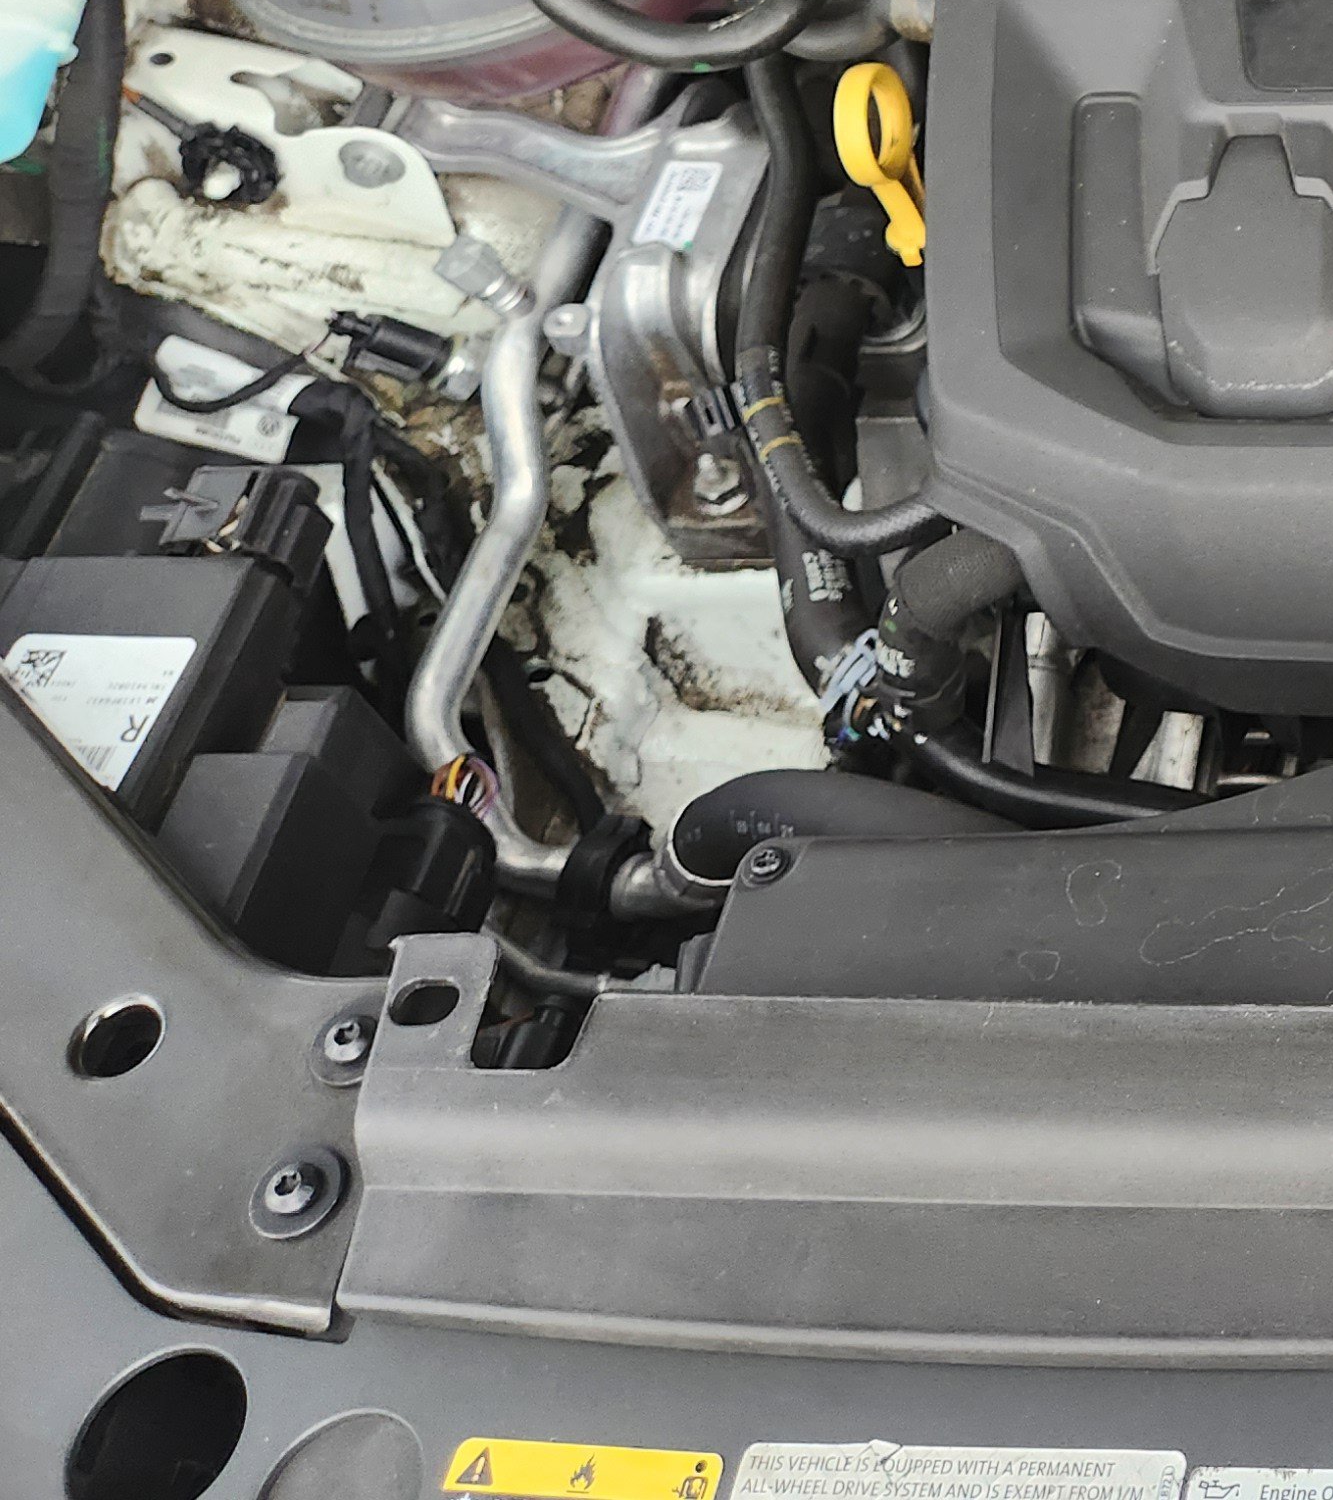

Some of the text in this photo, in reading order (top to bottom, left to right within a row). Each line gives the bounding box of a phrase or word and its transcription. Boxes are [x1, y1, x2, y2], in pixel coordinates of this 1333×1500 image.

[750, 1454, 1117, 1479] THIS VEHICLE IS EQUIPPED WITH A PERMANENT
[740, 1477, 829, 1495] ALL-WHEEL
[832, 1479, 881, 1496] DRIVE
[881, 1480, 942, 1498] SYSTEM
[945, 1483, 983, 1498] AND
[985, 1484, 1000, 1499] IS
[1004, 1484, 1066, 1500] EXEMPT
[1069, 1485, 1115, 1500] FROM
[1260, 1484, 1318, 1500] Engine
